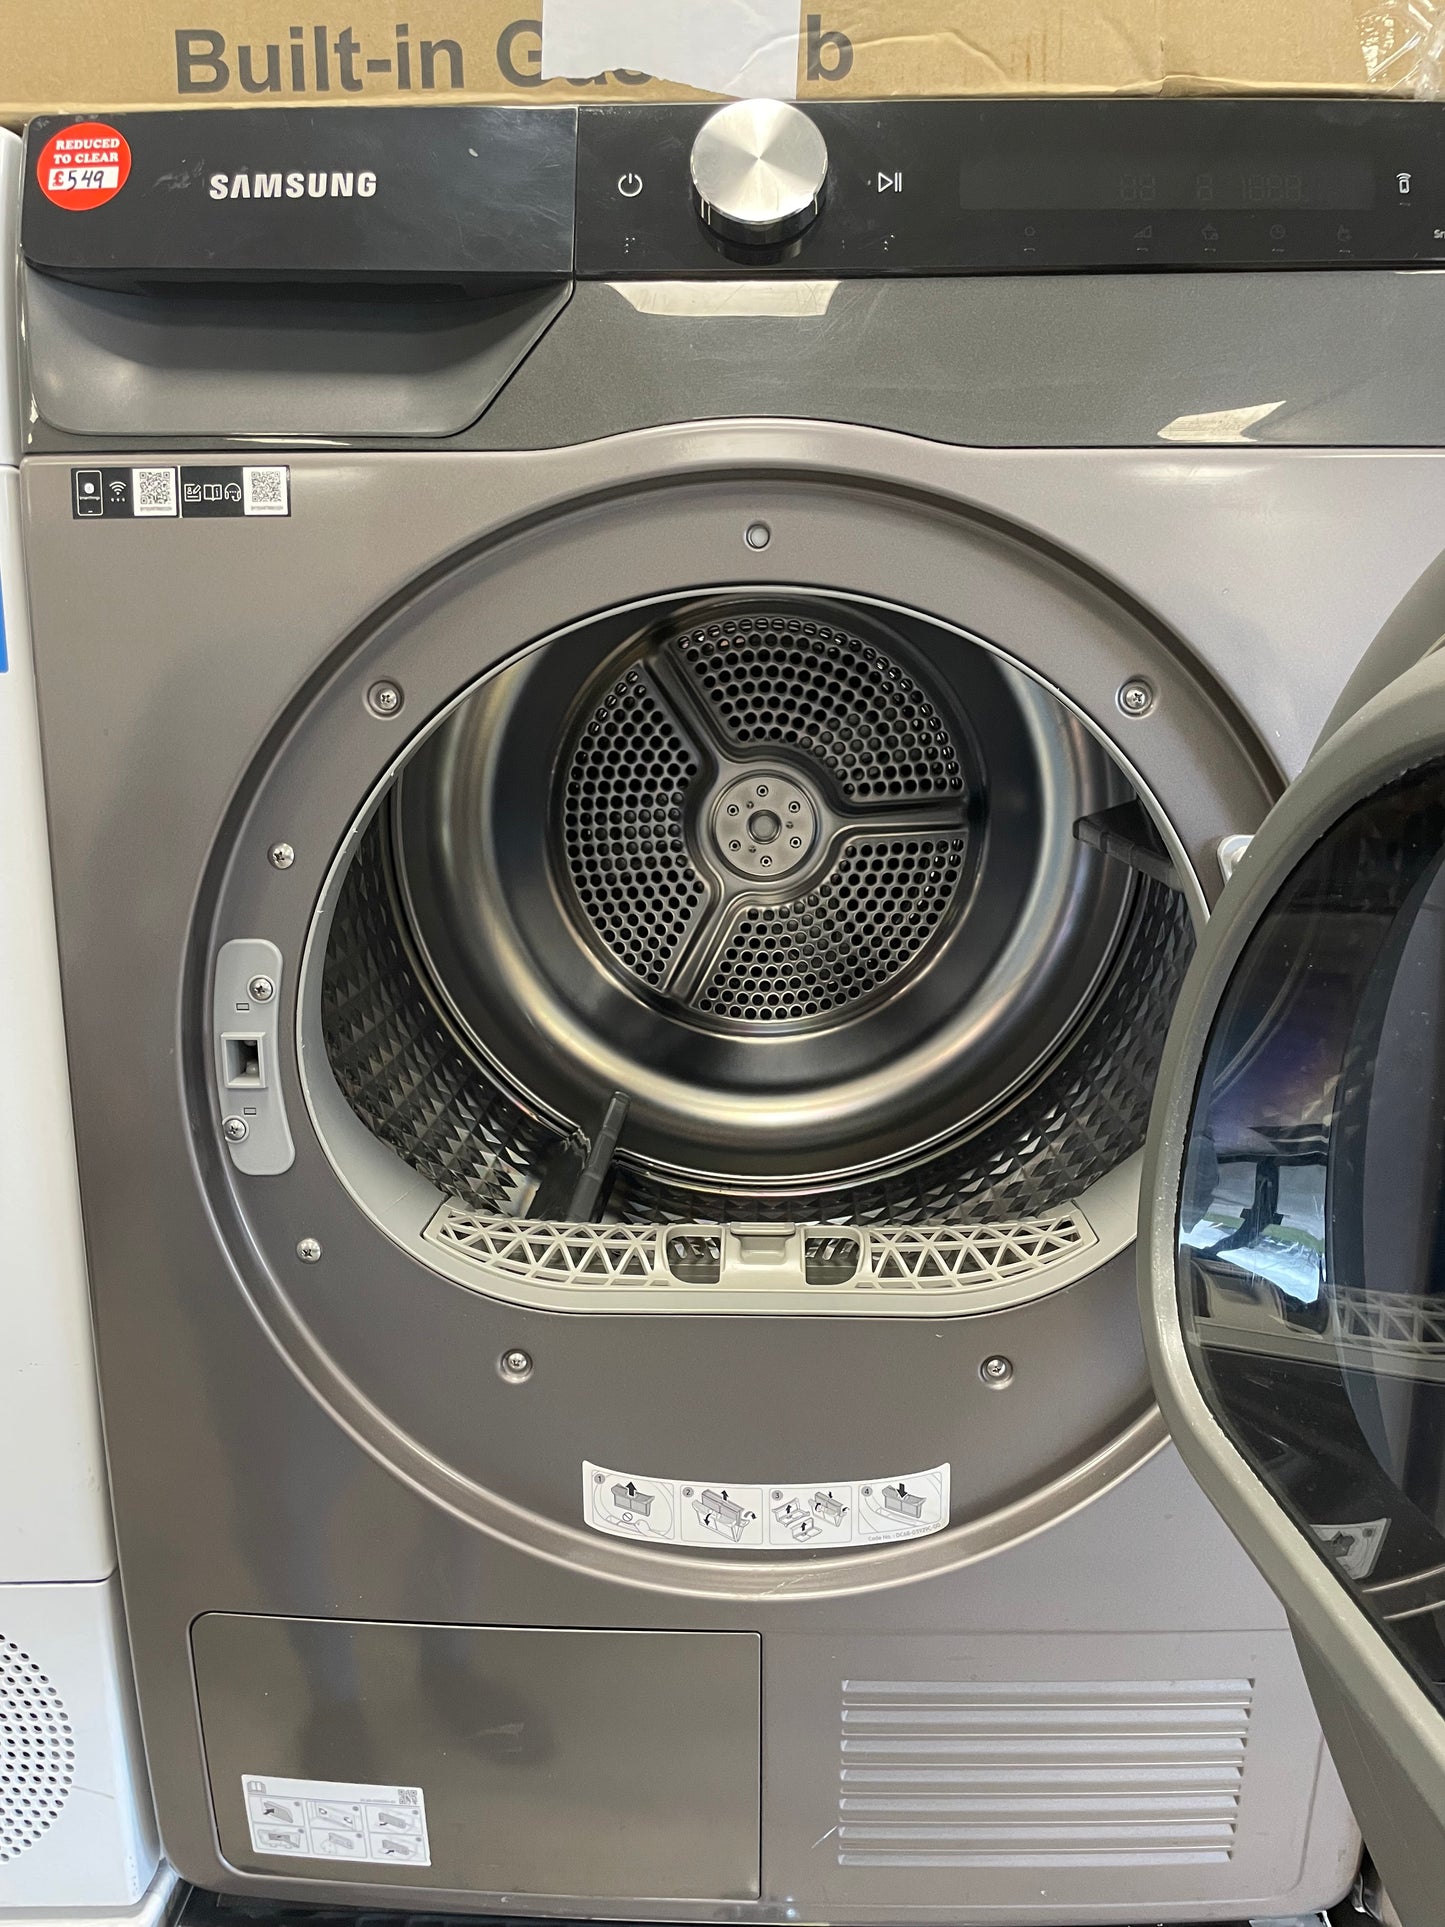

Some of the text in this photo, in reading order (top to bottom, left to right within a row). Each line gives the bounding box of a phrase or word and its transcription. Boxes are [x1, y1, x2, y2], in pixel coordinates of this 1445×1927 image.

[175, 23, 464, 94] Built-in
[55, 138, 120, 151] REDUCED
[53, 151, 119, 165] TO CLEAR
[209, 172, 377, 200] SAMSUNG
